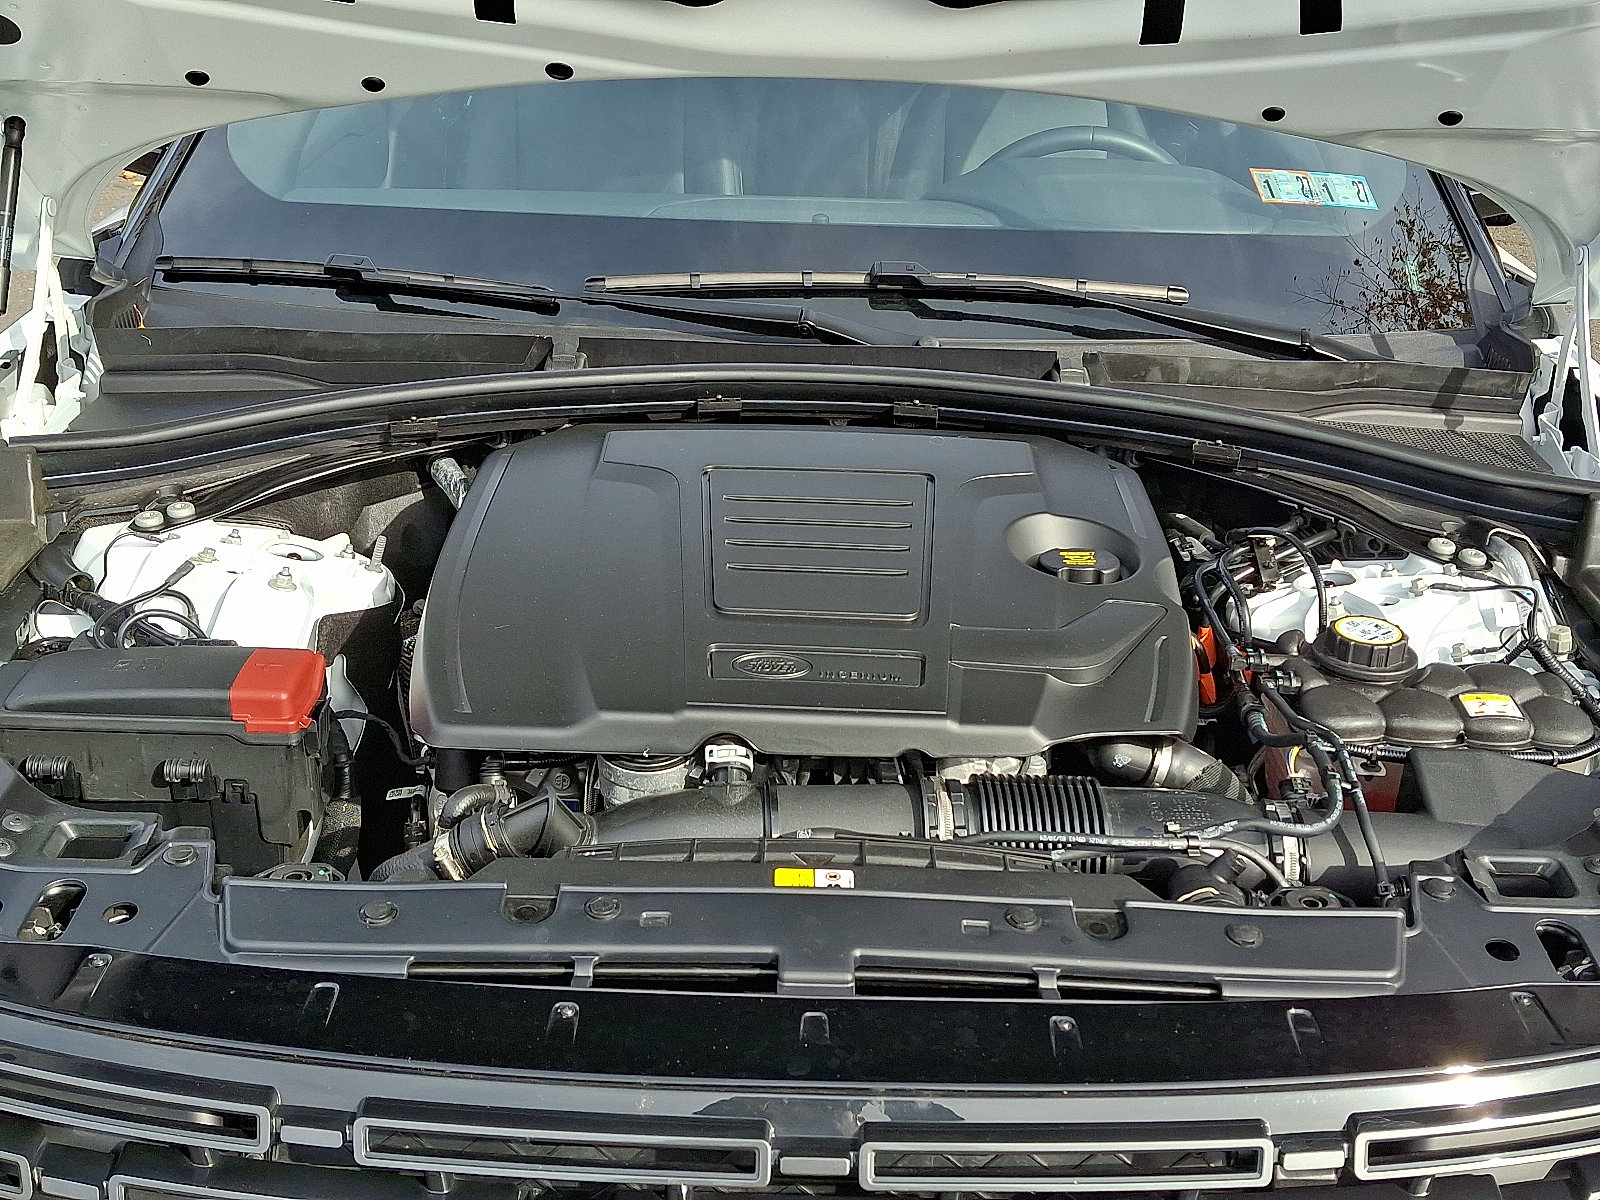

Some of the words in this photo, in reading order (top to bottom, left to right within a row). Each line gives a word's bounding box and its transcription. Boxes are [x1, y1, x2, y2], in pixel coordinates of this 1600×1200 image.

[1263, 179, 1276, 199] 1
[1295, 176, 1314, 199] 27
[1322, 182, 1335, 203] 1
[1351, 181, 1370, 204] 27
[819, 670, 903, 682] INGENIUM
